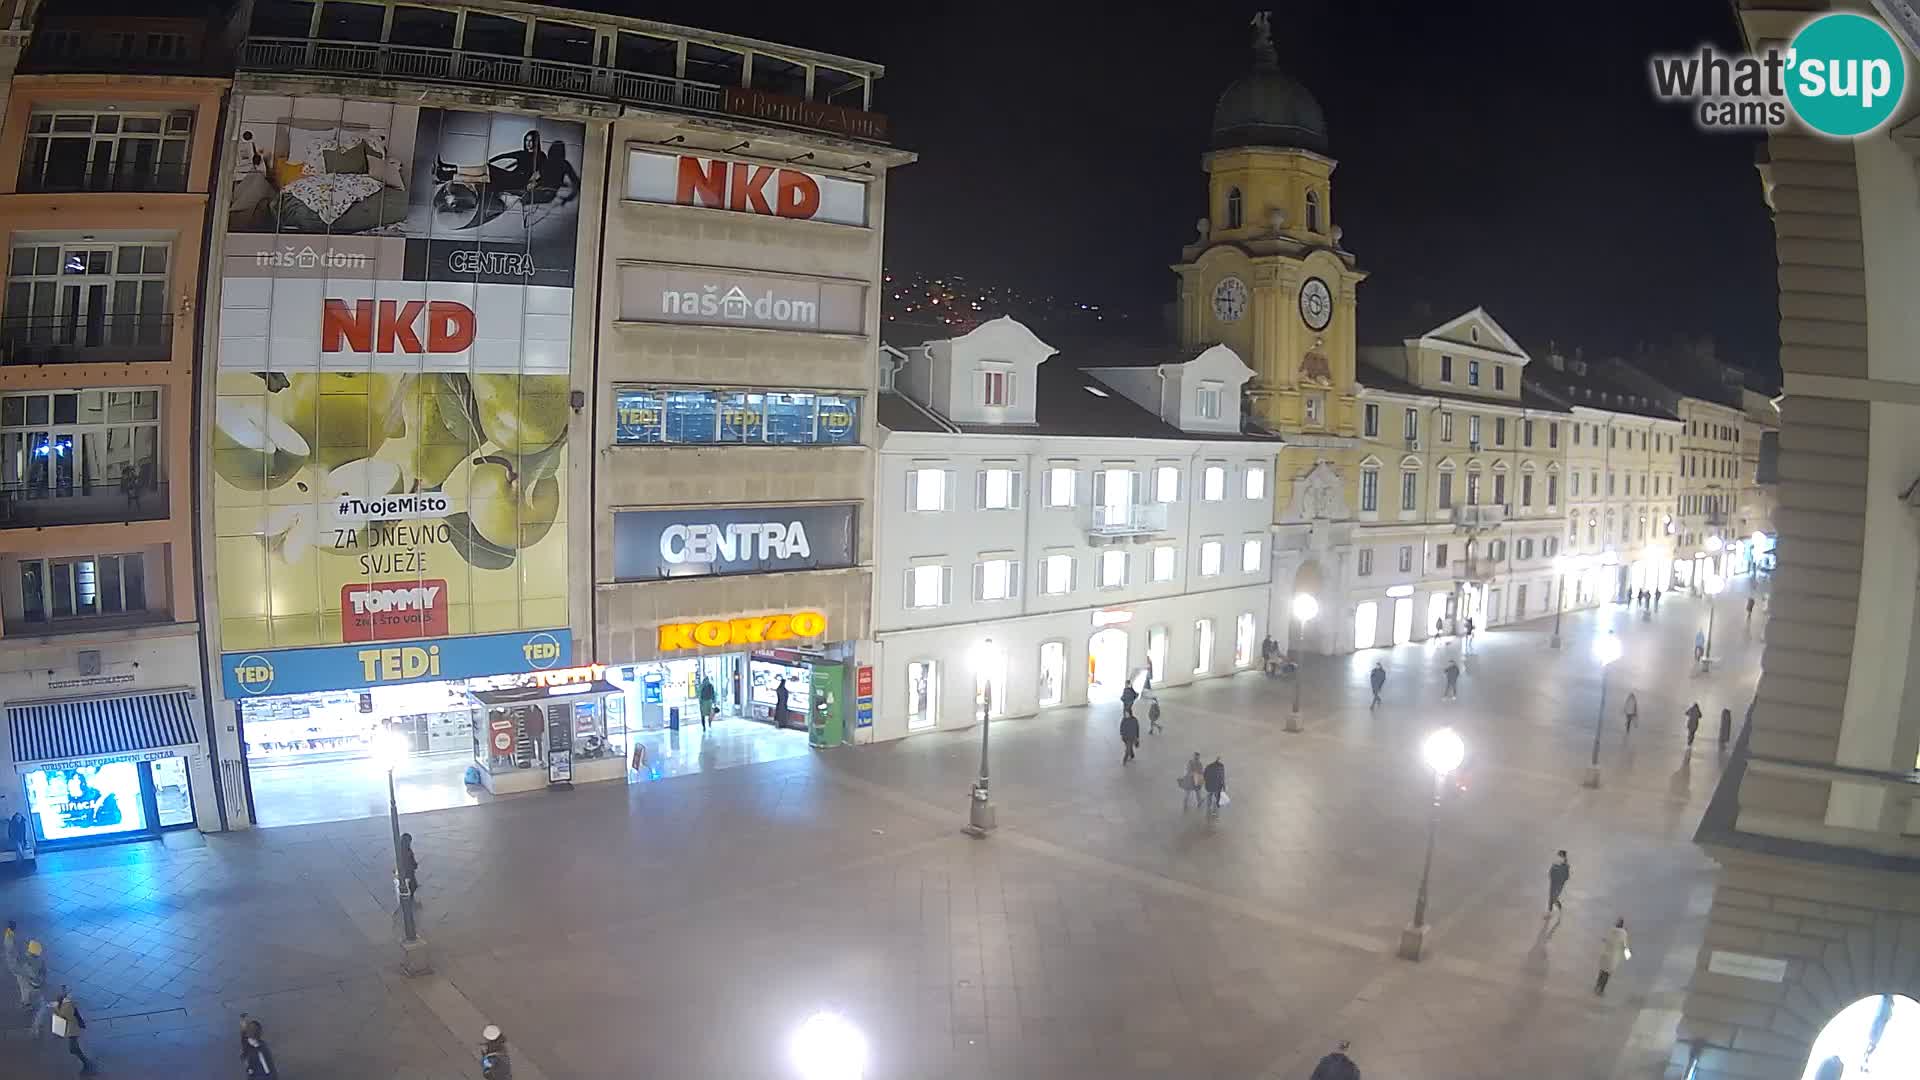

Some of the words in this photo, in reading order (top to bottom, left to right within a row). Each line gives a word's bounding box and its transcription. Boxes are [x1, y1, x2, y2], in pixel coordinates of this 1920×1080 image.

[676, 155, 820, 220] NKD
[256, 247, 294, 268] naš
[320, 246, 365, 269] dom
[448, 250, 535, 276] CENTRA
[662, 285, 717, 315] naš
[754, 290, 816, 323] dom
[321, 298, 477, 354] NKD
[338, 497, 447, 516] #TvojeMisto
[334, 529, 358, 549] ZA
[368, 524, 451, 548] DNEVNO
[660, 521, 811, 564] CENTRA
[360, 548, 427, 575] SVJEŽE
[350, 586, 440, 614] TOMMY
[658, 612, 826, 652] KORZO
[359, 645, 440, 682] TEDi
[523, 642, 560, 660] TEDi
[235, 666, 274, 684] TEDi
